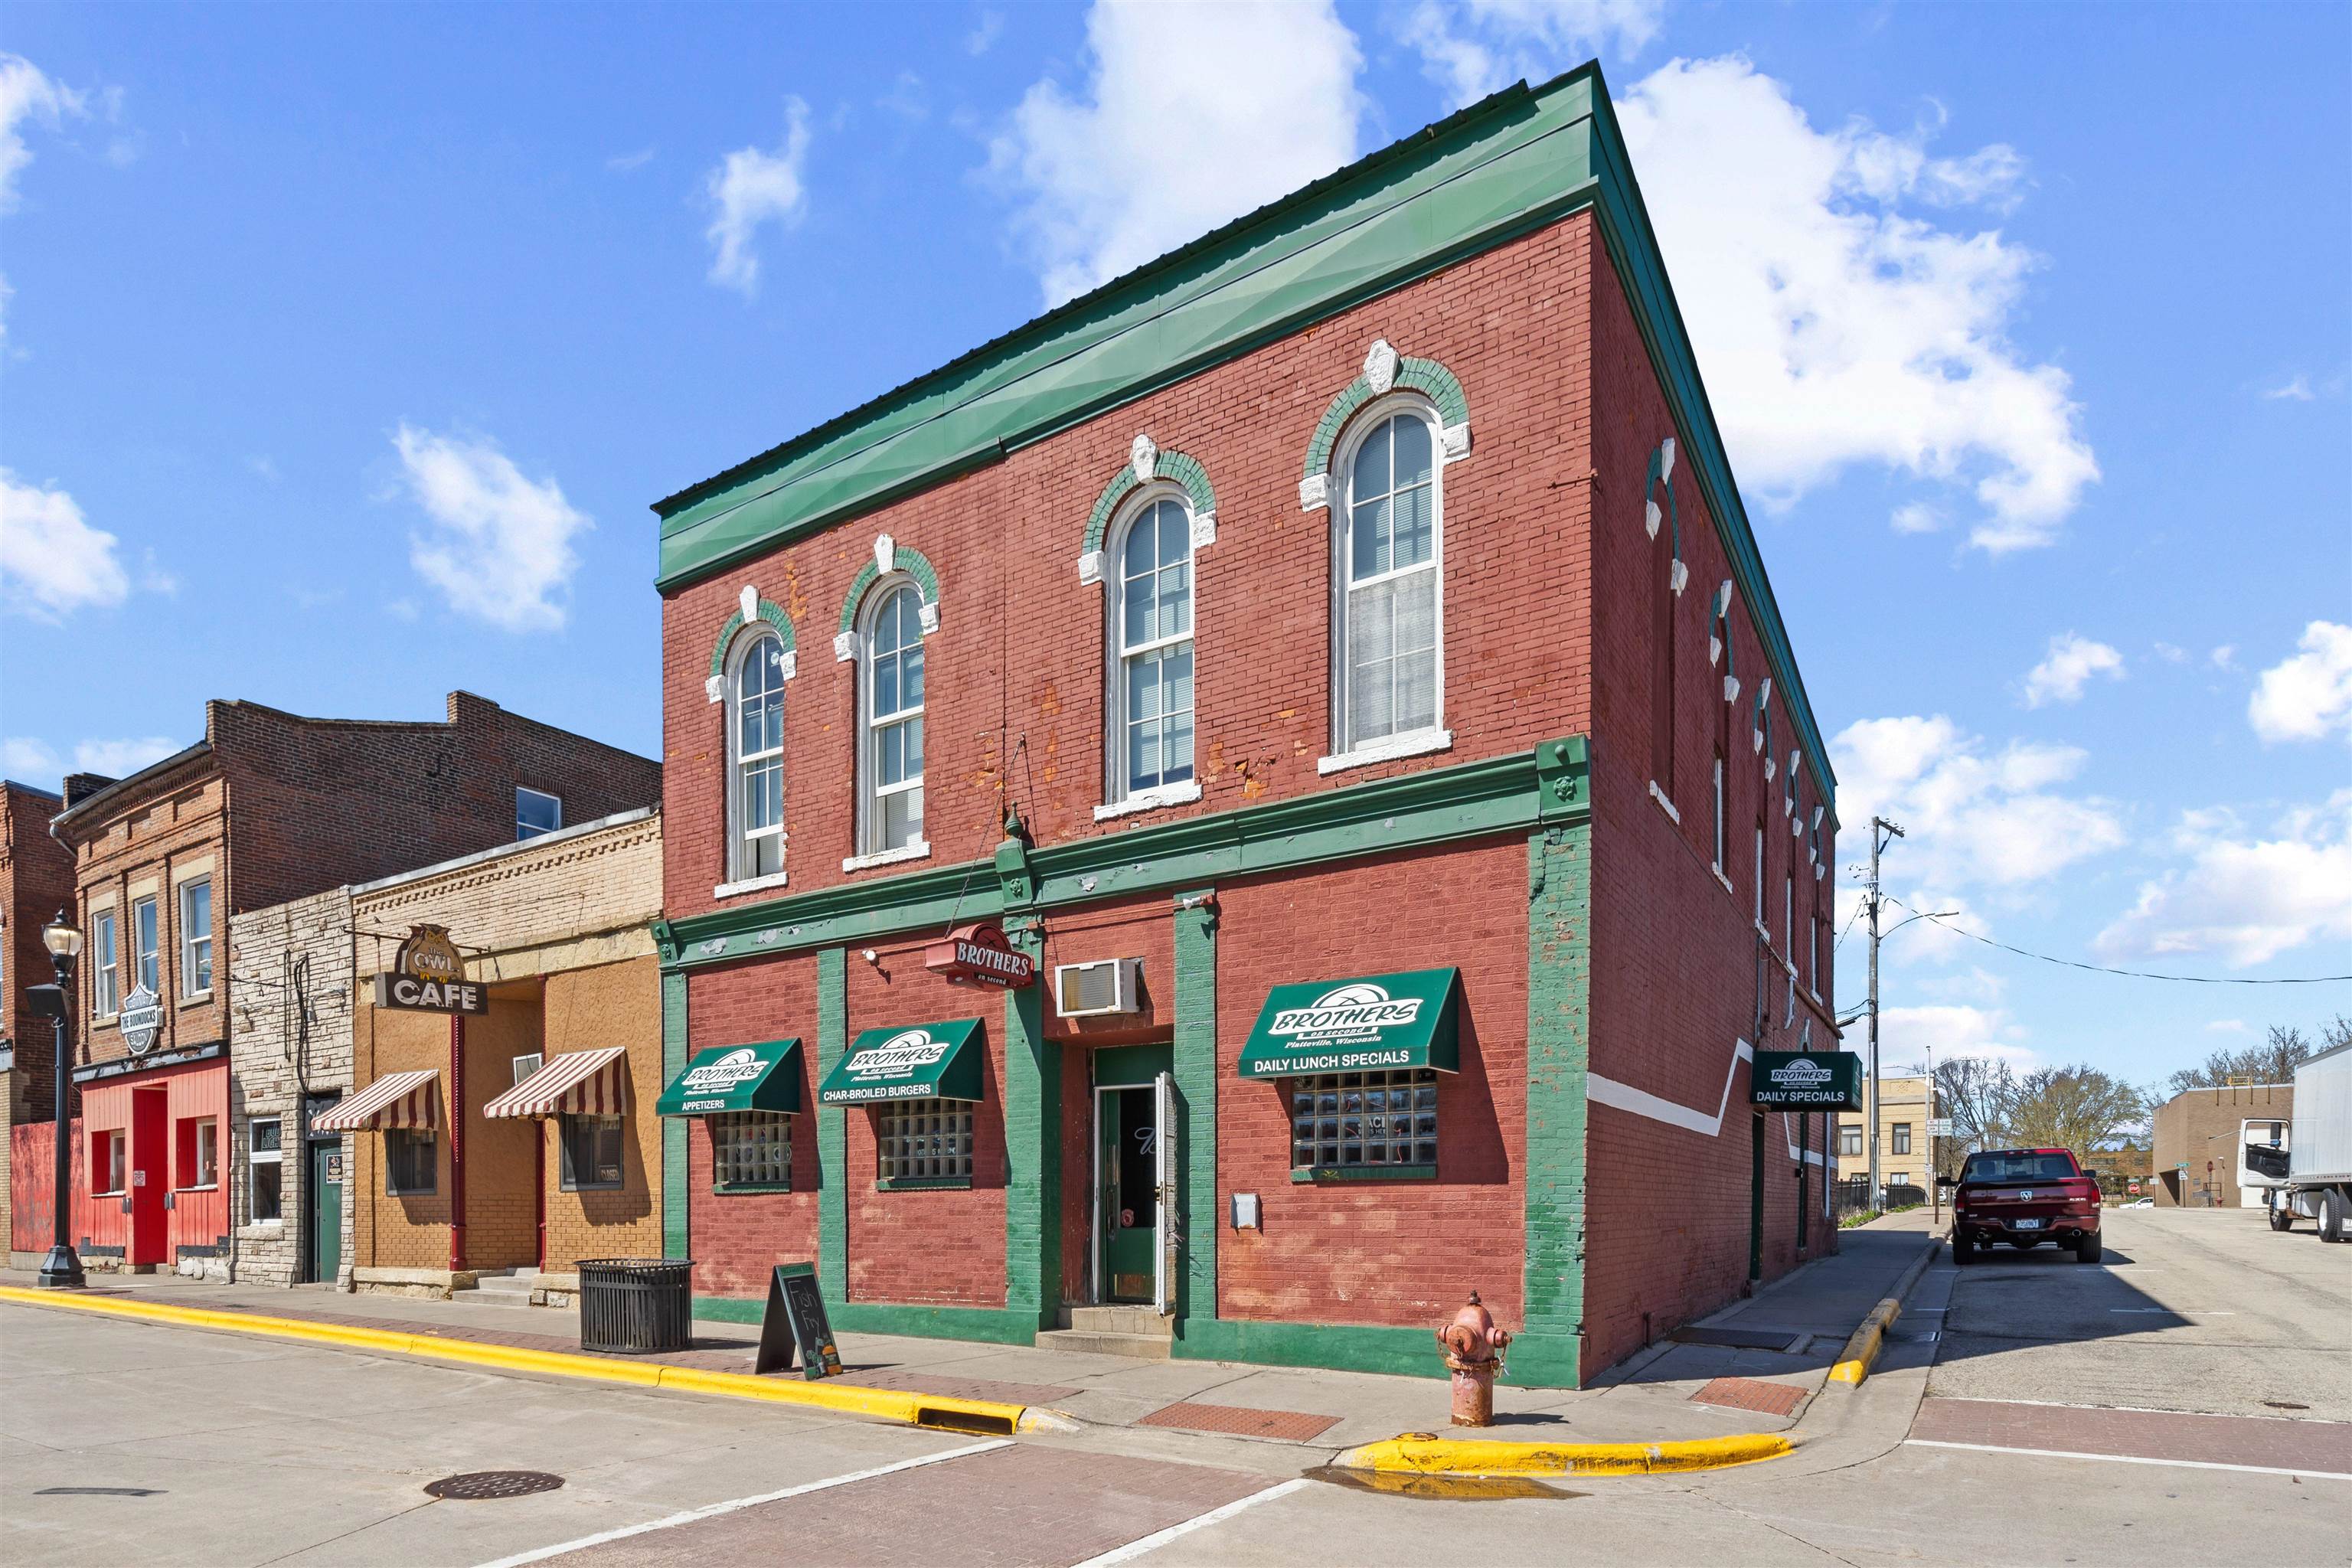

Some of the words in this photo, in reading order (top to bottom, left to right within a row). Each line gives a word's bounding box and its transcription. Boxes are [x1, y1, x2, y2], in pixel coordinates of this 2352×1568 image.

[414, 952, 460, 972] OWL
[957, 942, 1029, 976] BROTHERS
[987, 976, 1007, 985] second
[394, 979, 479, 1010] CAFE
[1276, 1001, 1418, 1031] BROTHERS
[1325, 1027, 1365, 1036] second
[1284, 1039, 1333, 1049] Platteville,
[1335, 1035, 1382, 1045] Wisconsin
[851, 1046, 944, 1067] BROTHERS
[1254, 1058, 1290, 1073] DAILY
[1292, 1055, 1339, 1069] LUNCH
[1341, 1050, 1410, 1067] SPECIALS
[687, 1063, 765, 1081] BROTHERS
[1772, 1070, 1831, 1080] BROTHERS
[824, 1086, 887, 1101] CHAR-BROILED
[888, 1083, 931, 1096] BURGERS
[1756, 1091, 1787, 1102] DAILY
[1789, 1091, 1845, 1102] SPECIALS
[682, 1099, 725, 1111] APPETIZERS
[263, 1137, 281, 1148] LIGH
[787, 1279, 818, 1311] Fish
[801, 1310, 820, 1338] Fry
